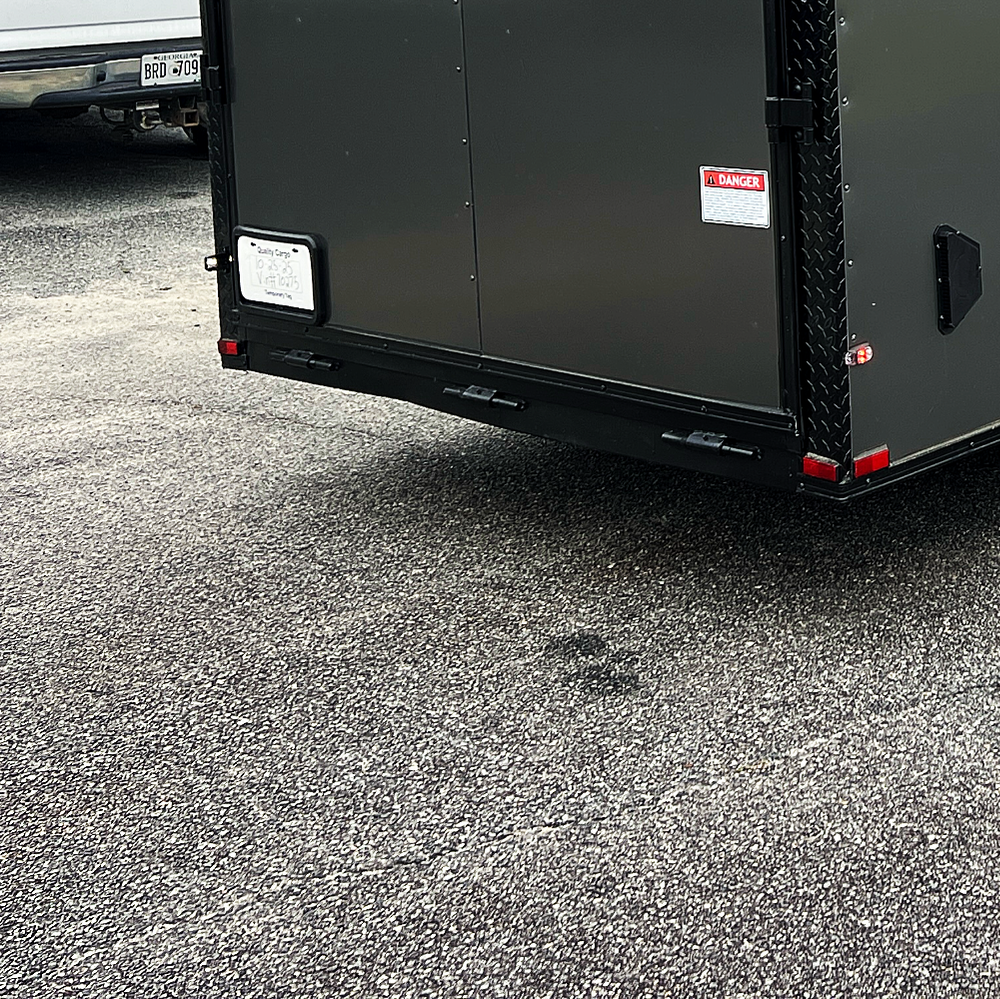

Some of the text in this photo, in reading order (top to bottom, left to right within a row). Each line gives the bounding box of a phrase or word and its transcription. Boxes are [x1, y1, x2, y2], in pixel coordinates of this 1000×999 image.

[157, 53, 194, 61] GEORGIA
[144, 59, 199, 80] BRD 709
[718, 174, 760, 188] DANGER
[257, 246, 291, 259] Quality Cargo
